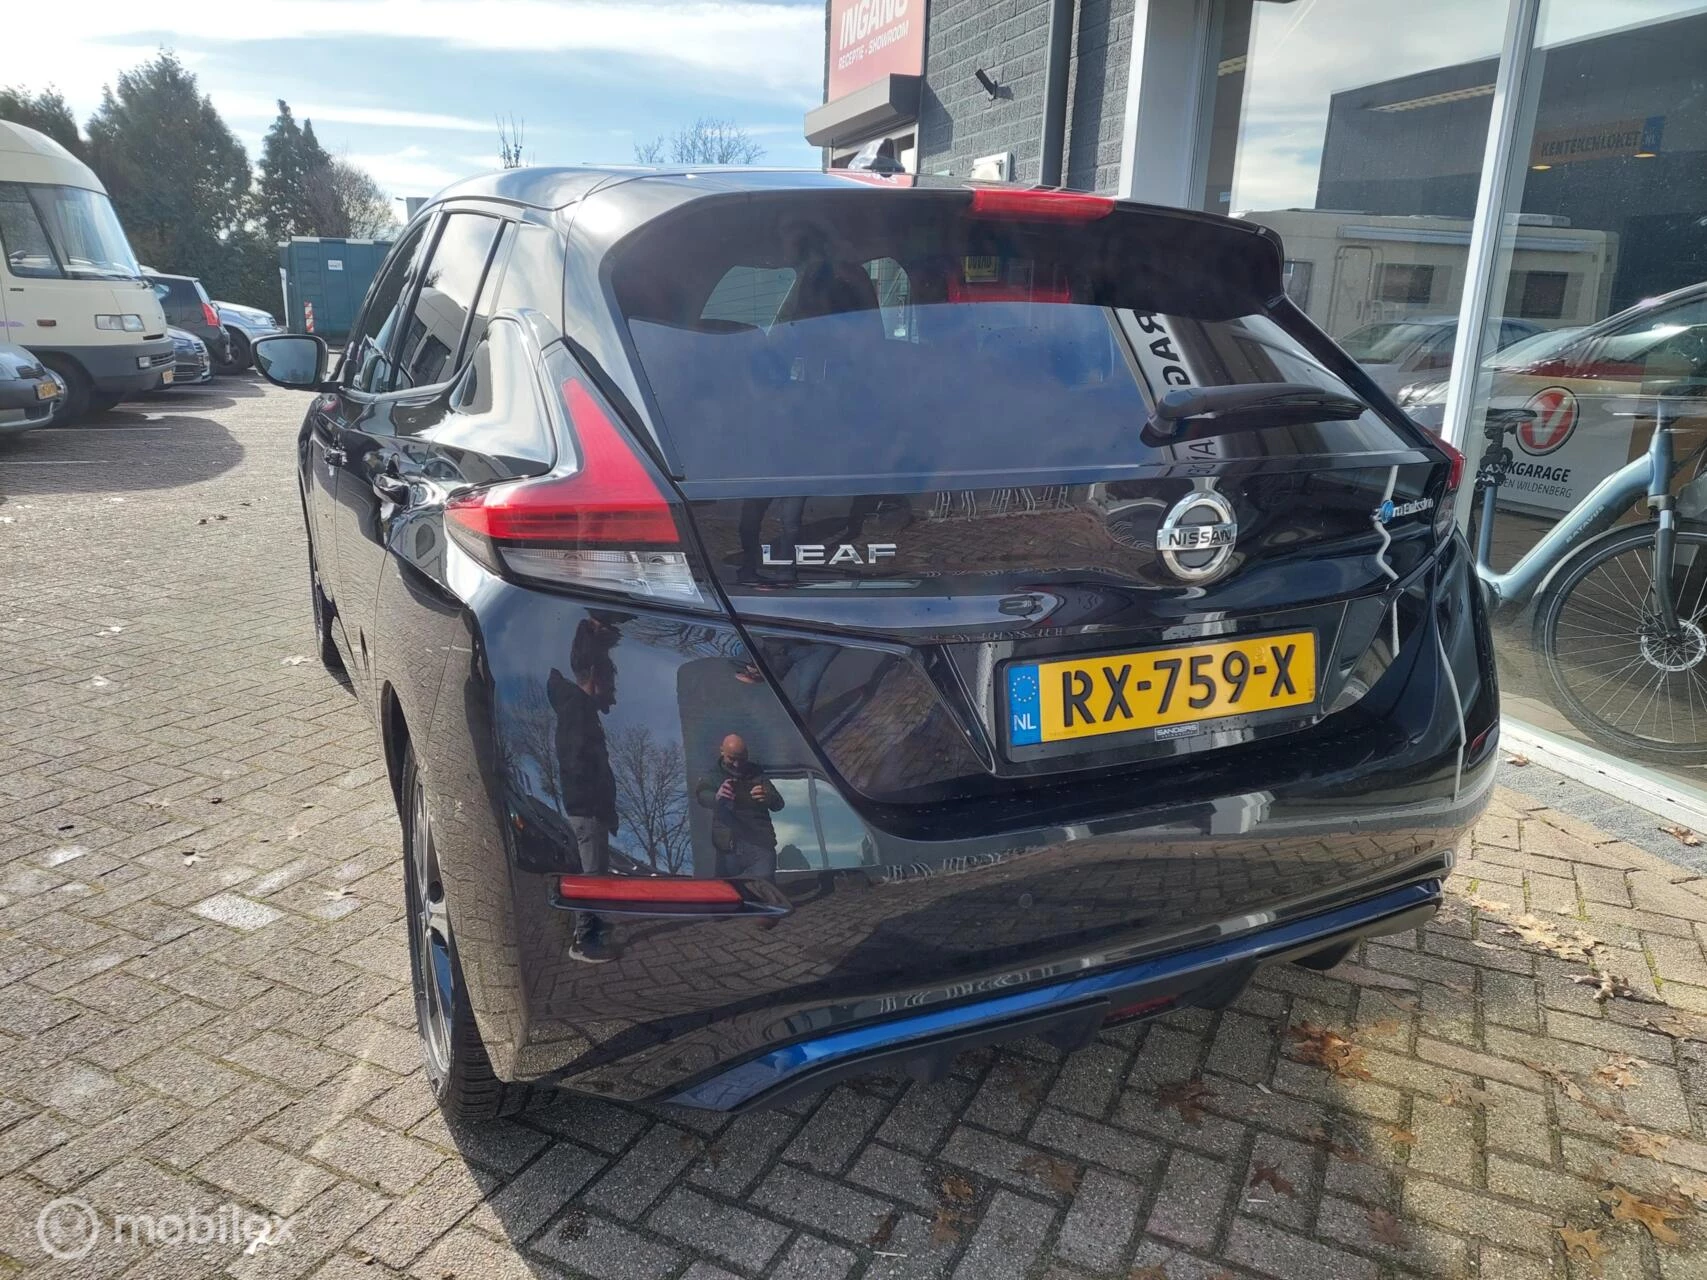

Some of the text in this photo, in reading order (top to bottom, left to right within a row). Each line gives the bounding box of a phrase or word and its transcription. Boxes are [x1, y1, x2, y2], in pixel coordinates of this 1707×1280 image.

[838, 20, 909, 70] RECEPTIE SHOWROOM
[1507, 461, 1571, 482] KGARAGE
[1517, 481, 1573, 498] WILDENBERG
[1169, 529, 1232, 546] NISSAN
[761, 544, 897, 565] LEAF
[1062, 644, 1296, 728] RX-759-X
[1013, 713, 1037, 731] NL
